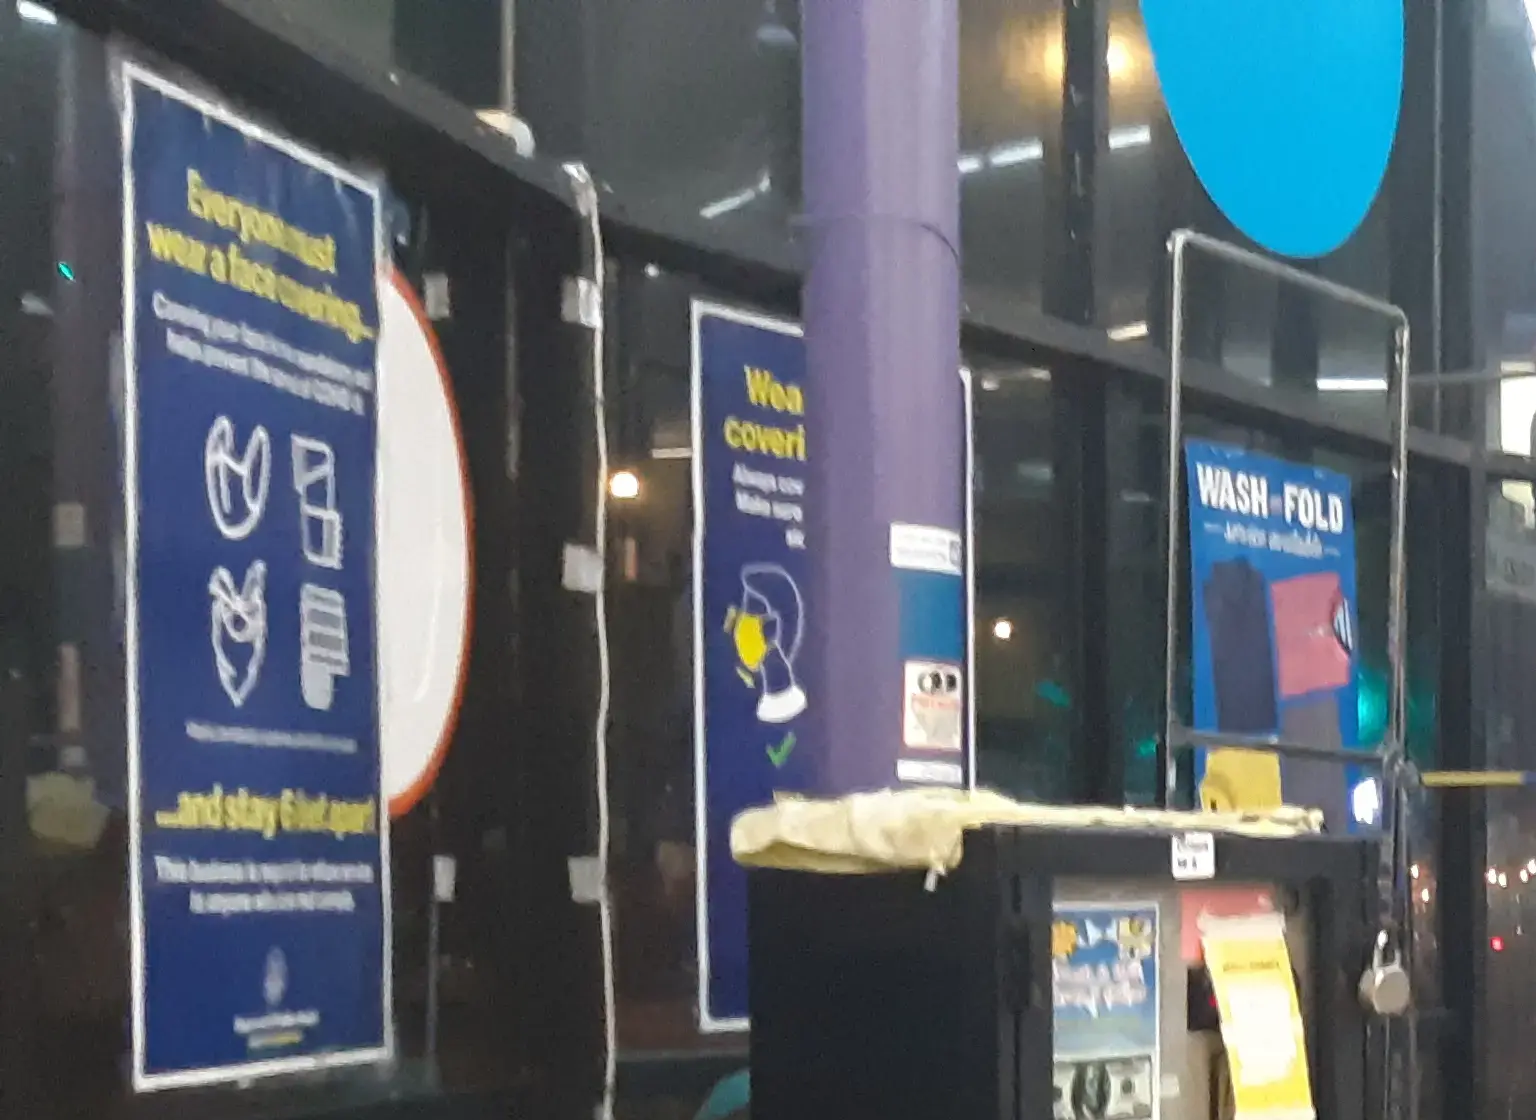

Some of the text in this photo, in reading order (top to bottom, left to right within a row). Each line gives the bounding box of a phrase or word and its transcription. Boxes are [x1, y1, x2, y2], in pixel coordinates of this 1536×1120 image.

[744, 364, 804, 416] Wea
[724, 416, 806, 460] coveri
[1196, 461, 1344, 534] WASH FOLD
